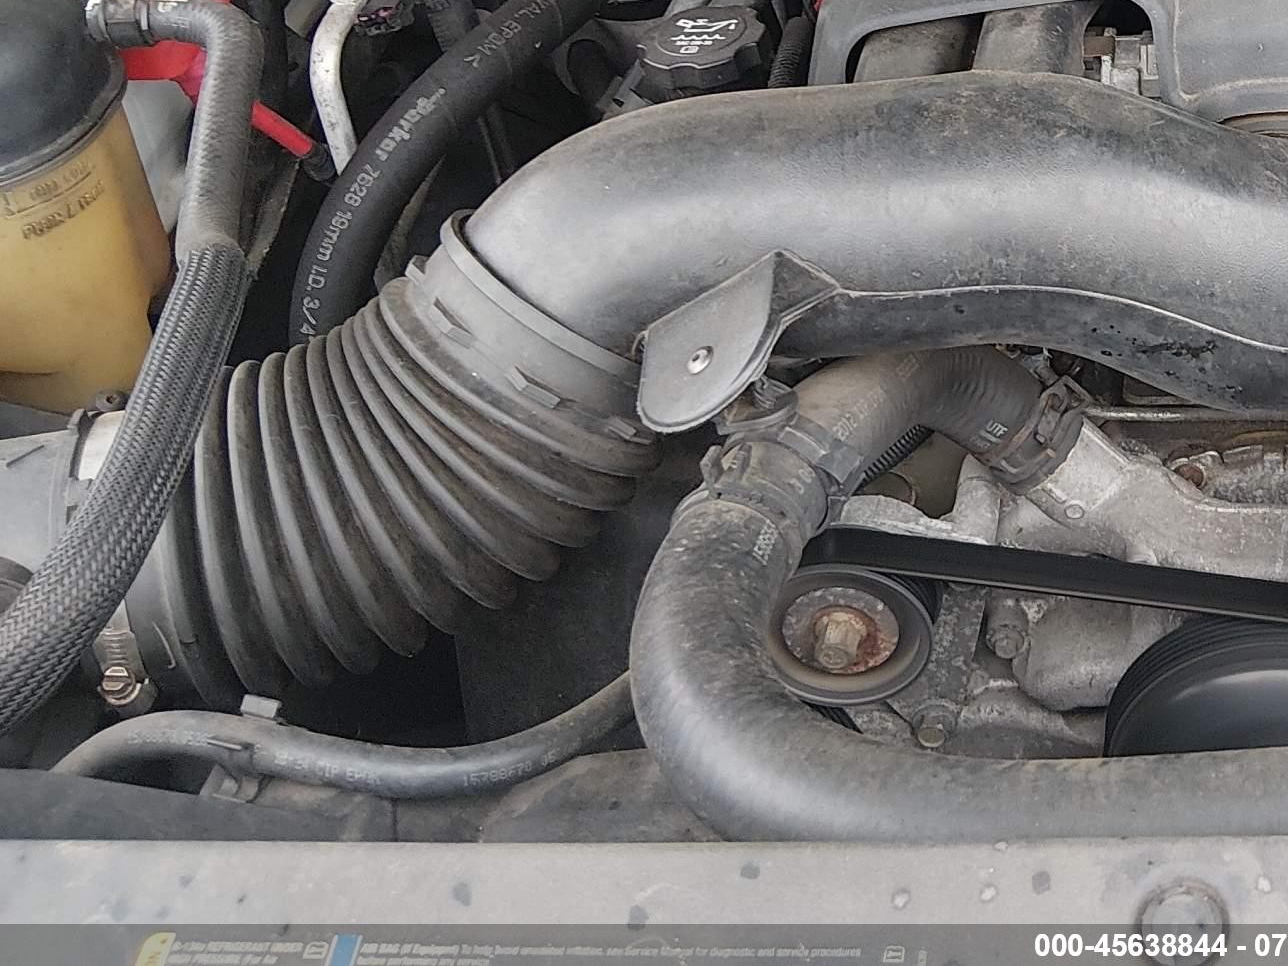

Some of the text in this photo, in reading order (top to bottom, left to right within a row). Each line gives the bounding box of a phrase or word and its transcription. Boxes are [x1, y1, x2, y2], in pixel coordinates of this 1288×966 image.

[344, 163, 381, 207] 7628
[316, 209, 353, 263] 19mm
[832, 413, 857, 442] 2012
[986, 418, 1009, 437] UTF
